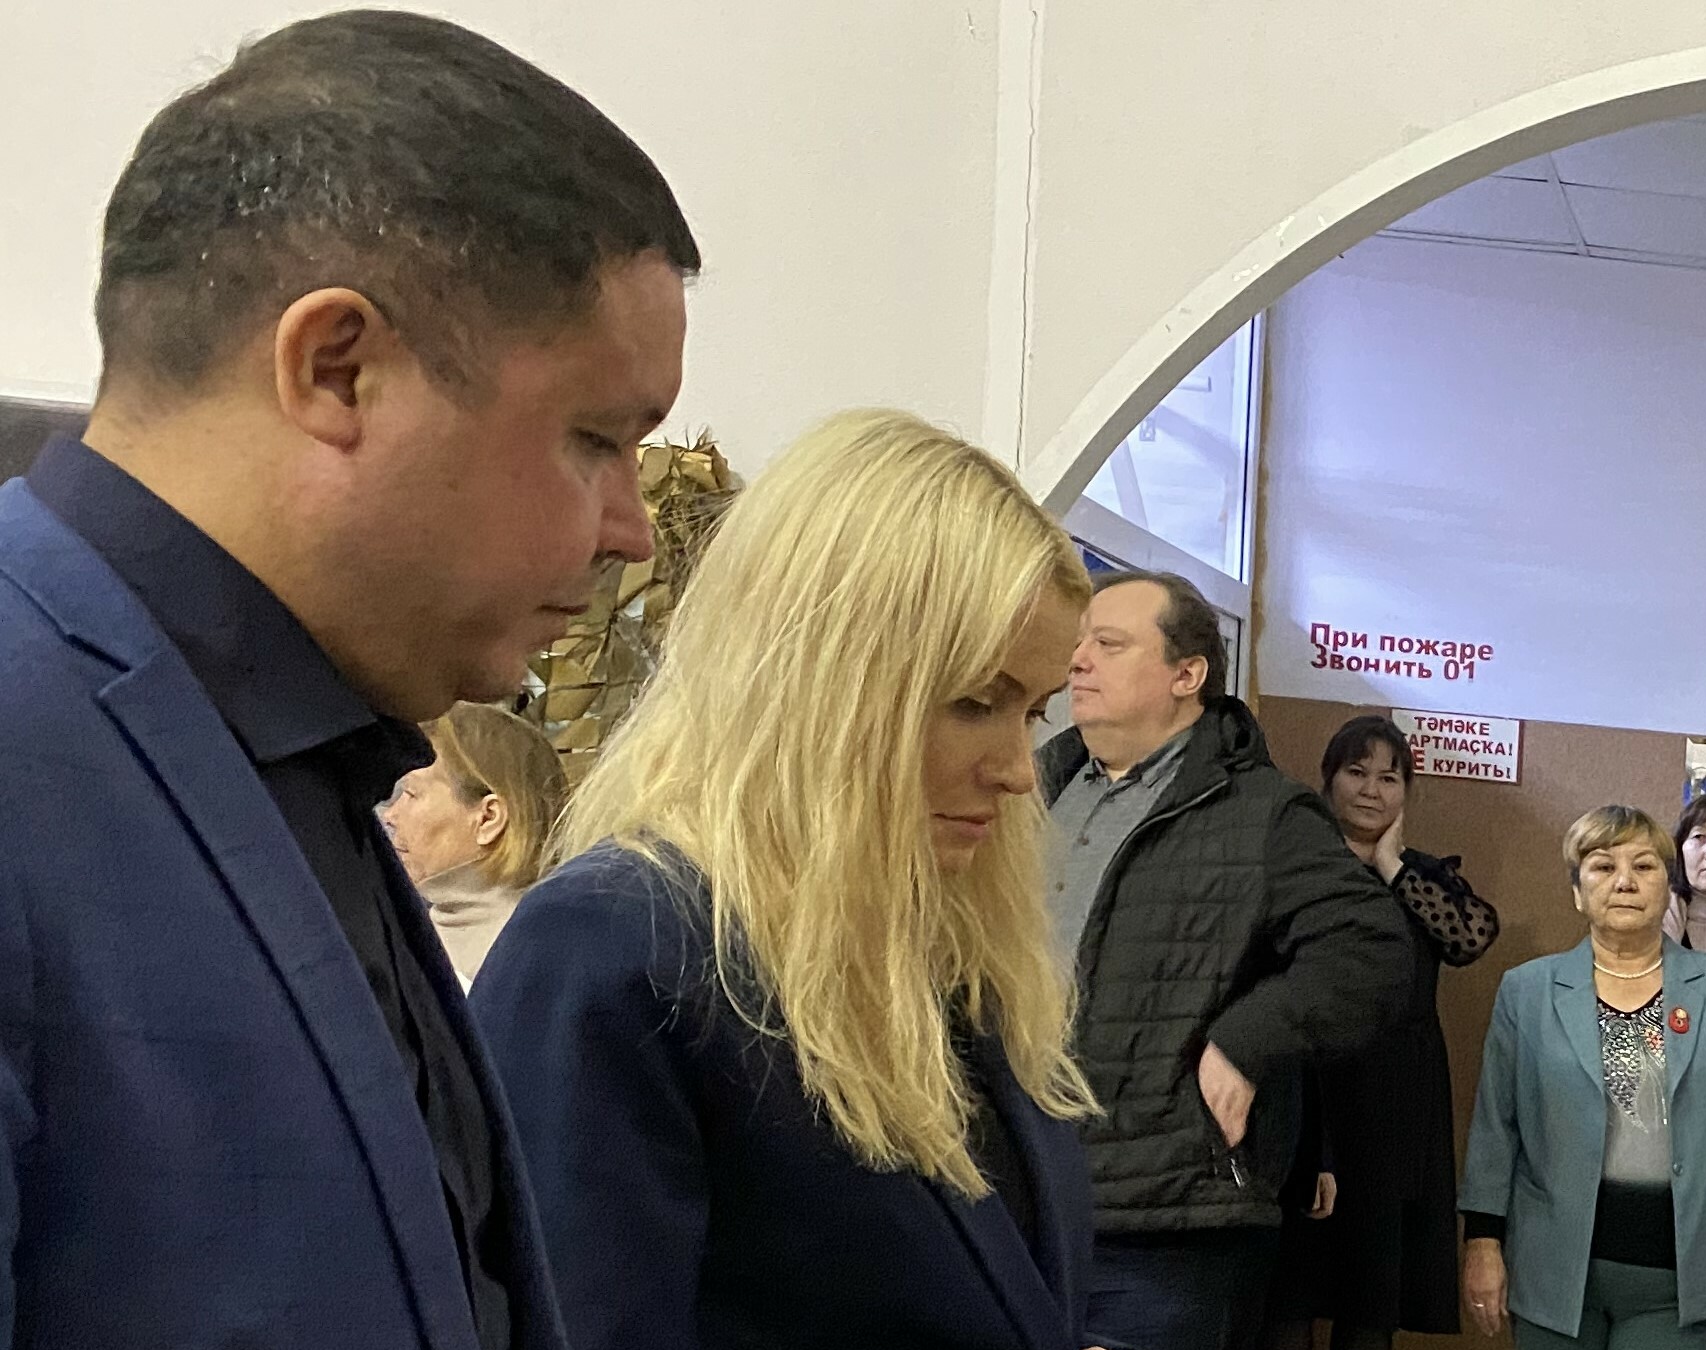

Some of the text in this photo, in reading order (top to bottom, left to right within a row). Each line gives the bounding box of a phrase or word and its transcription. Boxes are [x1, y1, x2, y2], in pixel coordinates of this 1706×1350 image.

[1310, 622, 1494, 664] При пожаре
[1310, 644, 1476, 683] Звонить 01
[1413, 715, 1491, 737] ТӘМӘКЕ
[1404, 733, 1514, 757] АРТМАҪҠА!
[1411, 747, 1426, 772] Е
